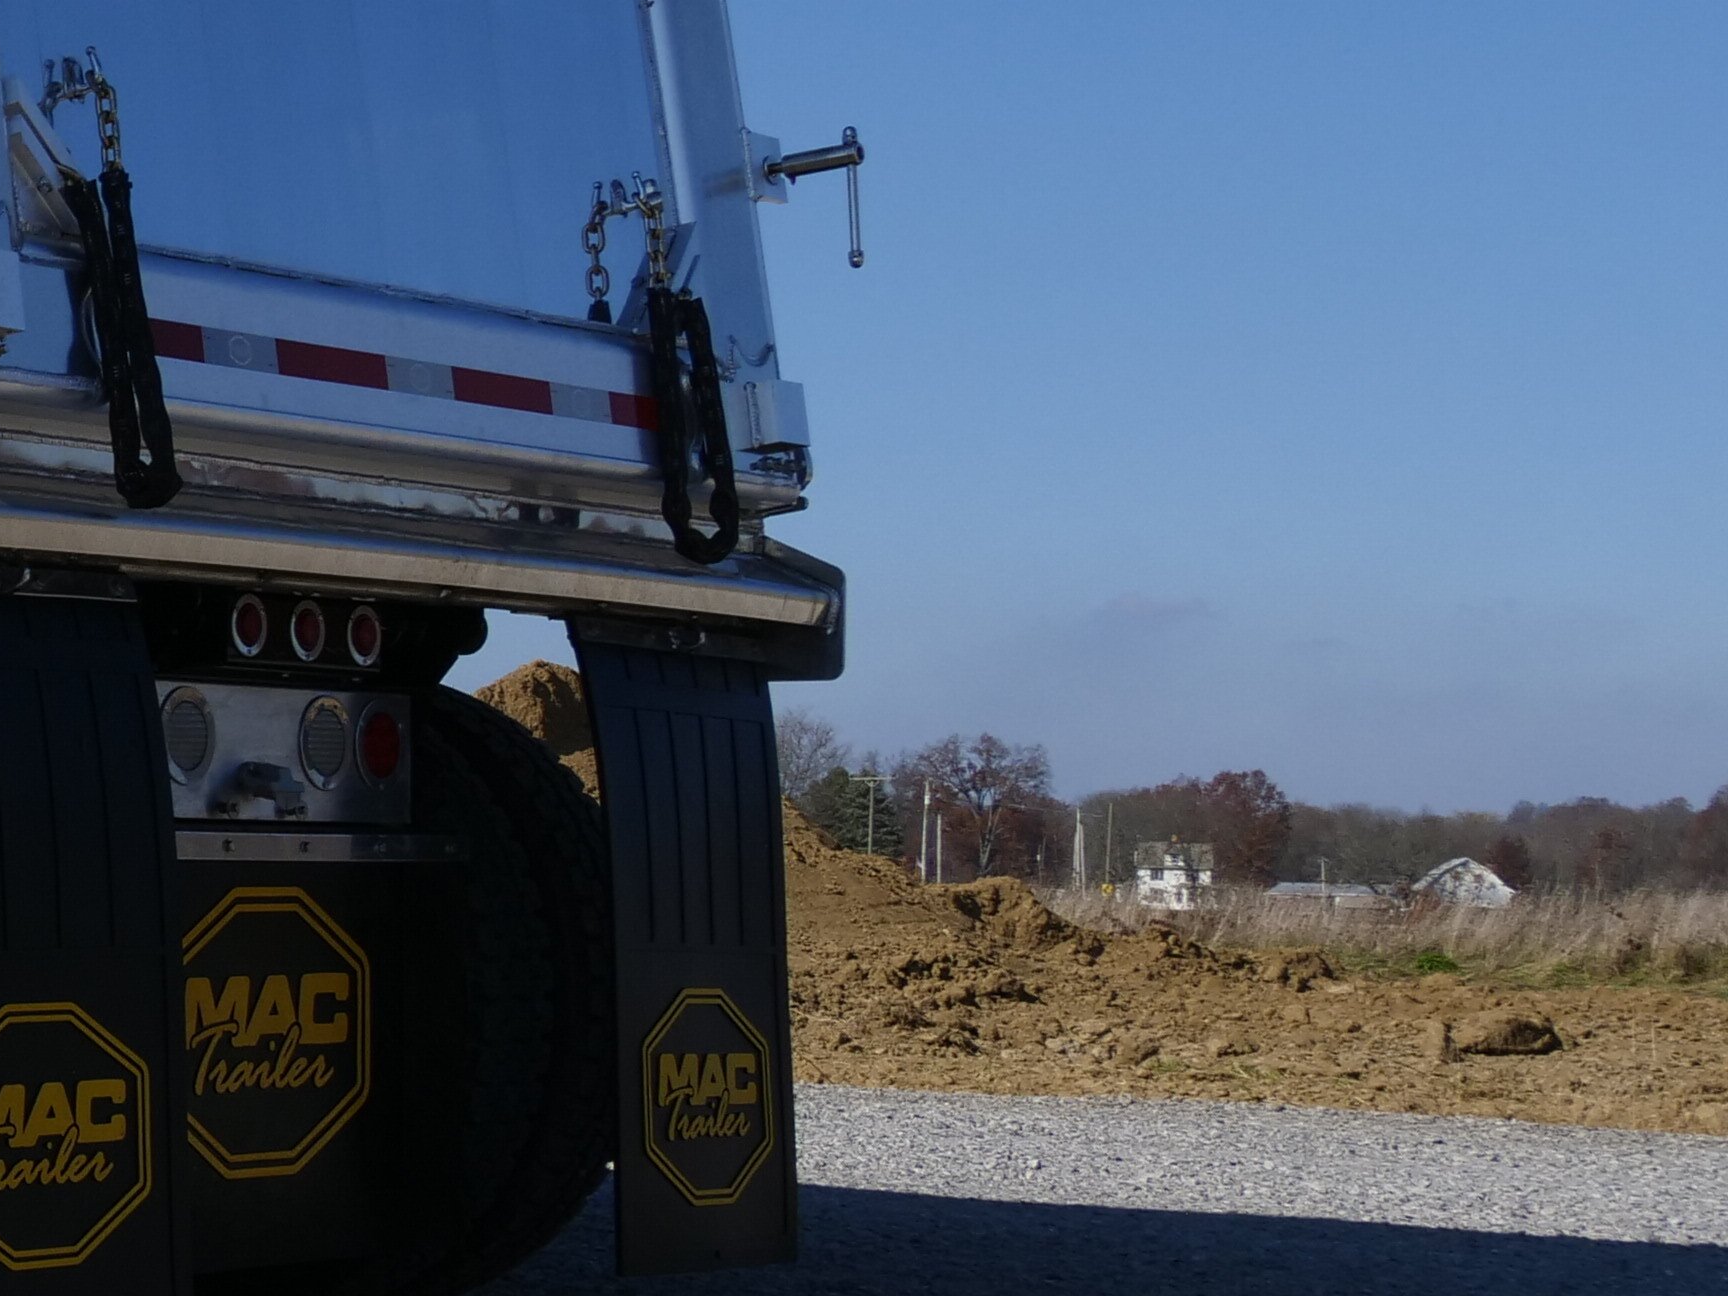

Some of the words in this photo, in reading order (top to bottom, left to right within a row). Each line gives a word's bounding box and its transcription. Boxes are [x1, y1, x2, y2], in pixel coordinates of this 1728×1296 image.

[185, 972, 350, 1050] MAC
[191, 1020, 335, 1096] Trailer
[658, 1052, 758, 1108] MAC
[665, 1086, 752, 1142] Trailer
